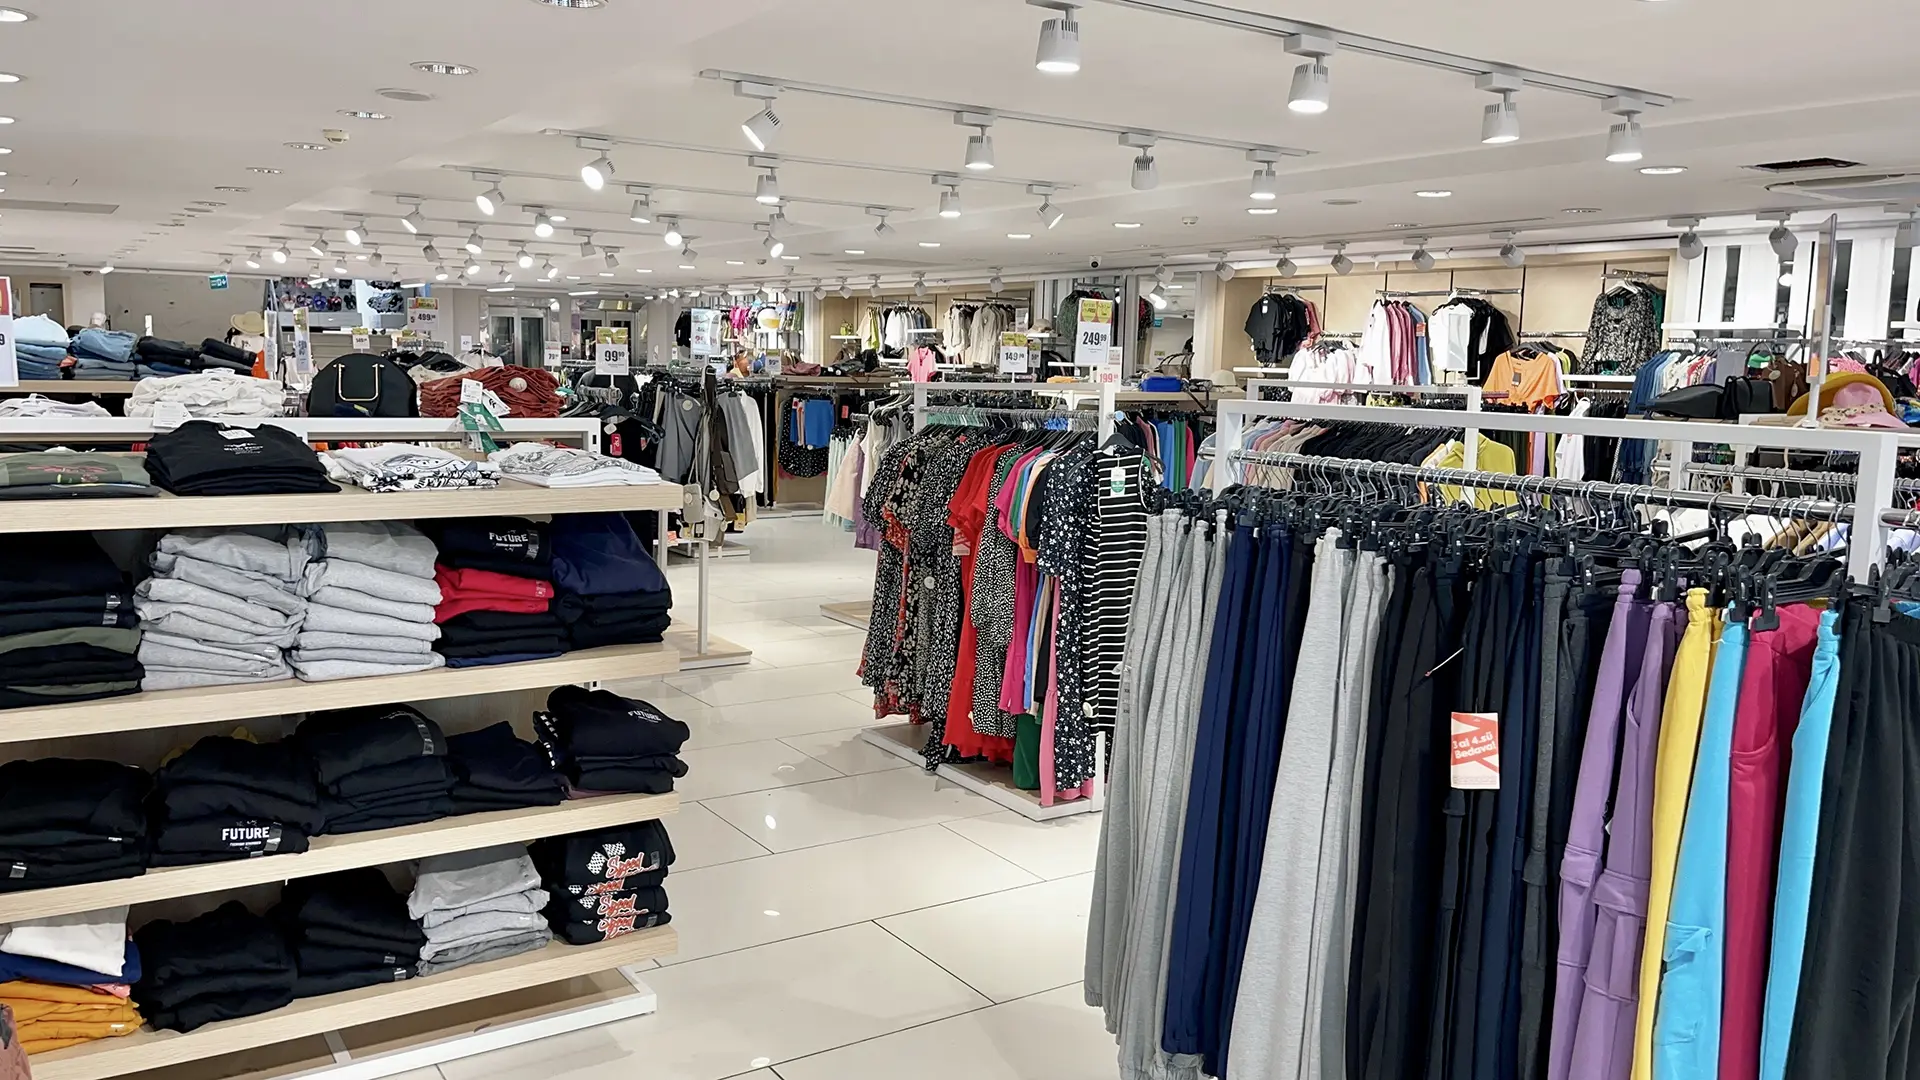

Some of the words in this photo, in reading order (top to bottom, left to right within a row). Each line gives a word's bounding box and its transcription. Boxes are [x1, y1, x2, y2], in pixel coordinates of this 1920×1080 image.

[1082, 331, 1101, 346] 249
[604, 350, 618, 362] 99
[489, 532, 529, 543] FUTURE
[1454, 741, 1497, 759] Bedava!
[221, 826, 270, 841] FUTURE
[605, 851, 645, 879] Speed
[597, 893, 638, 918] Speed
